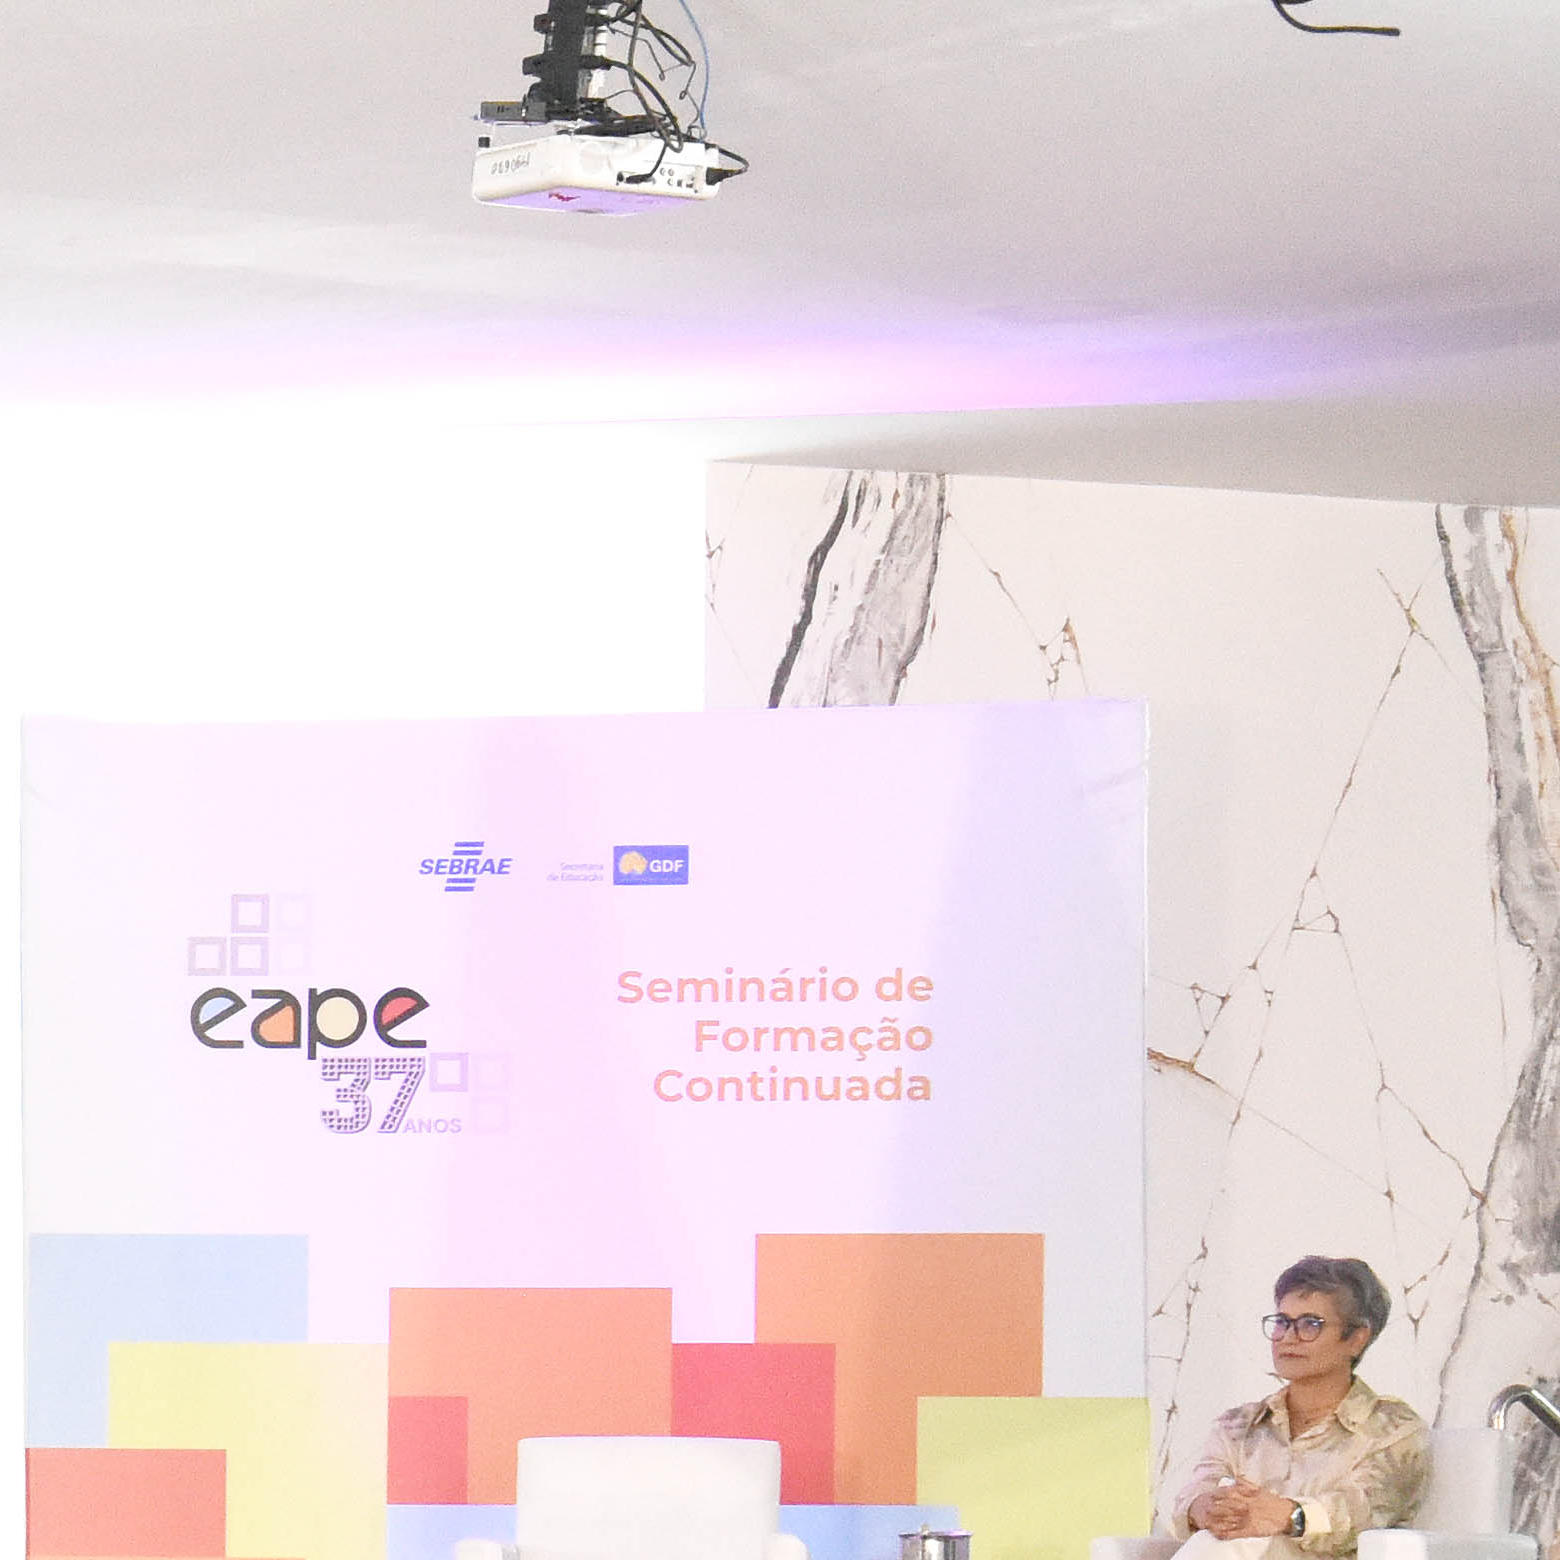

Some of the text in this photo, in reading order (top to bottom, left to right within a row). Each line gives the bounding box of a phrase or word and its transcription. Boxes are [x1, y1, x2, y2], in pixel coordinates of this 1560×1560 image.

[419, 858, 513, 875] SEBRAE
[649, 859, 685, 873] GDF
[617, 966, 934, 1004] Seminário de
[190, 987, 430, 1060] eape
[695, 1016, 934, 1062] Formação
[321, 1057, 463, 1134] 37 ANOS
[654, 1065, 932, 1102] Continuada
